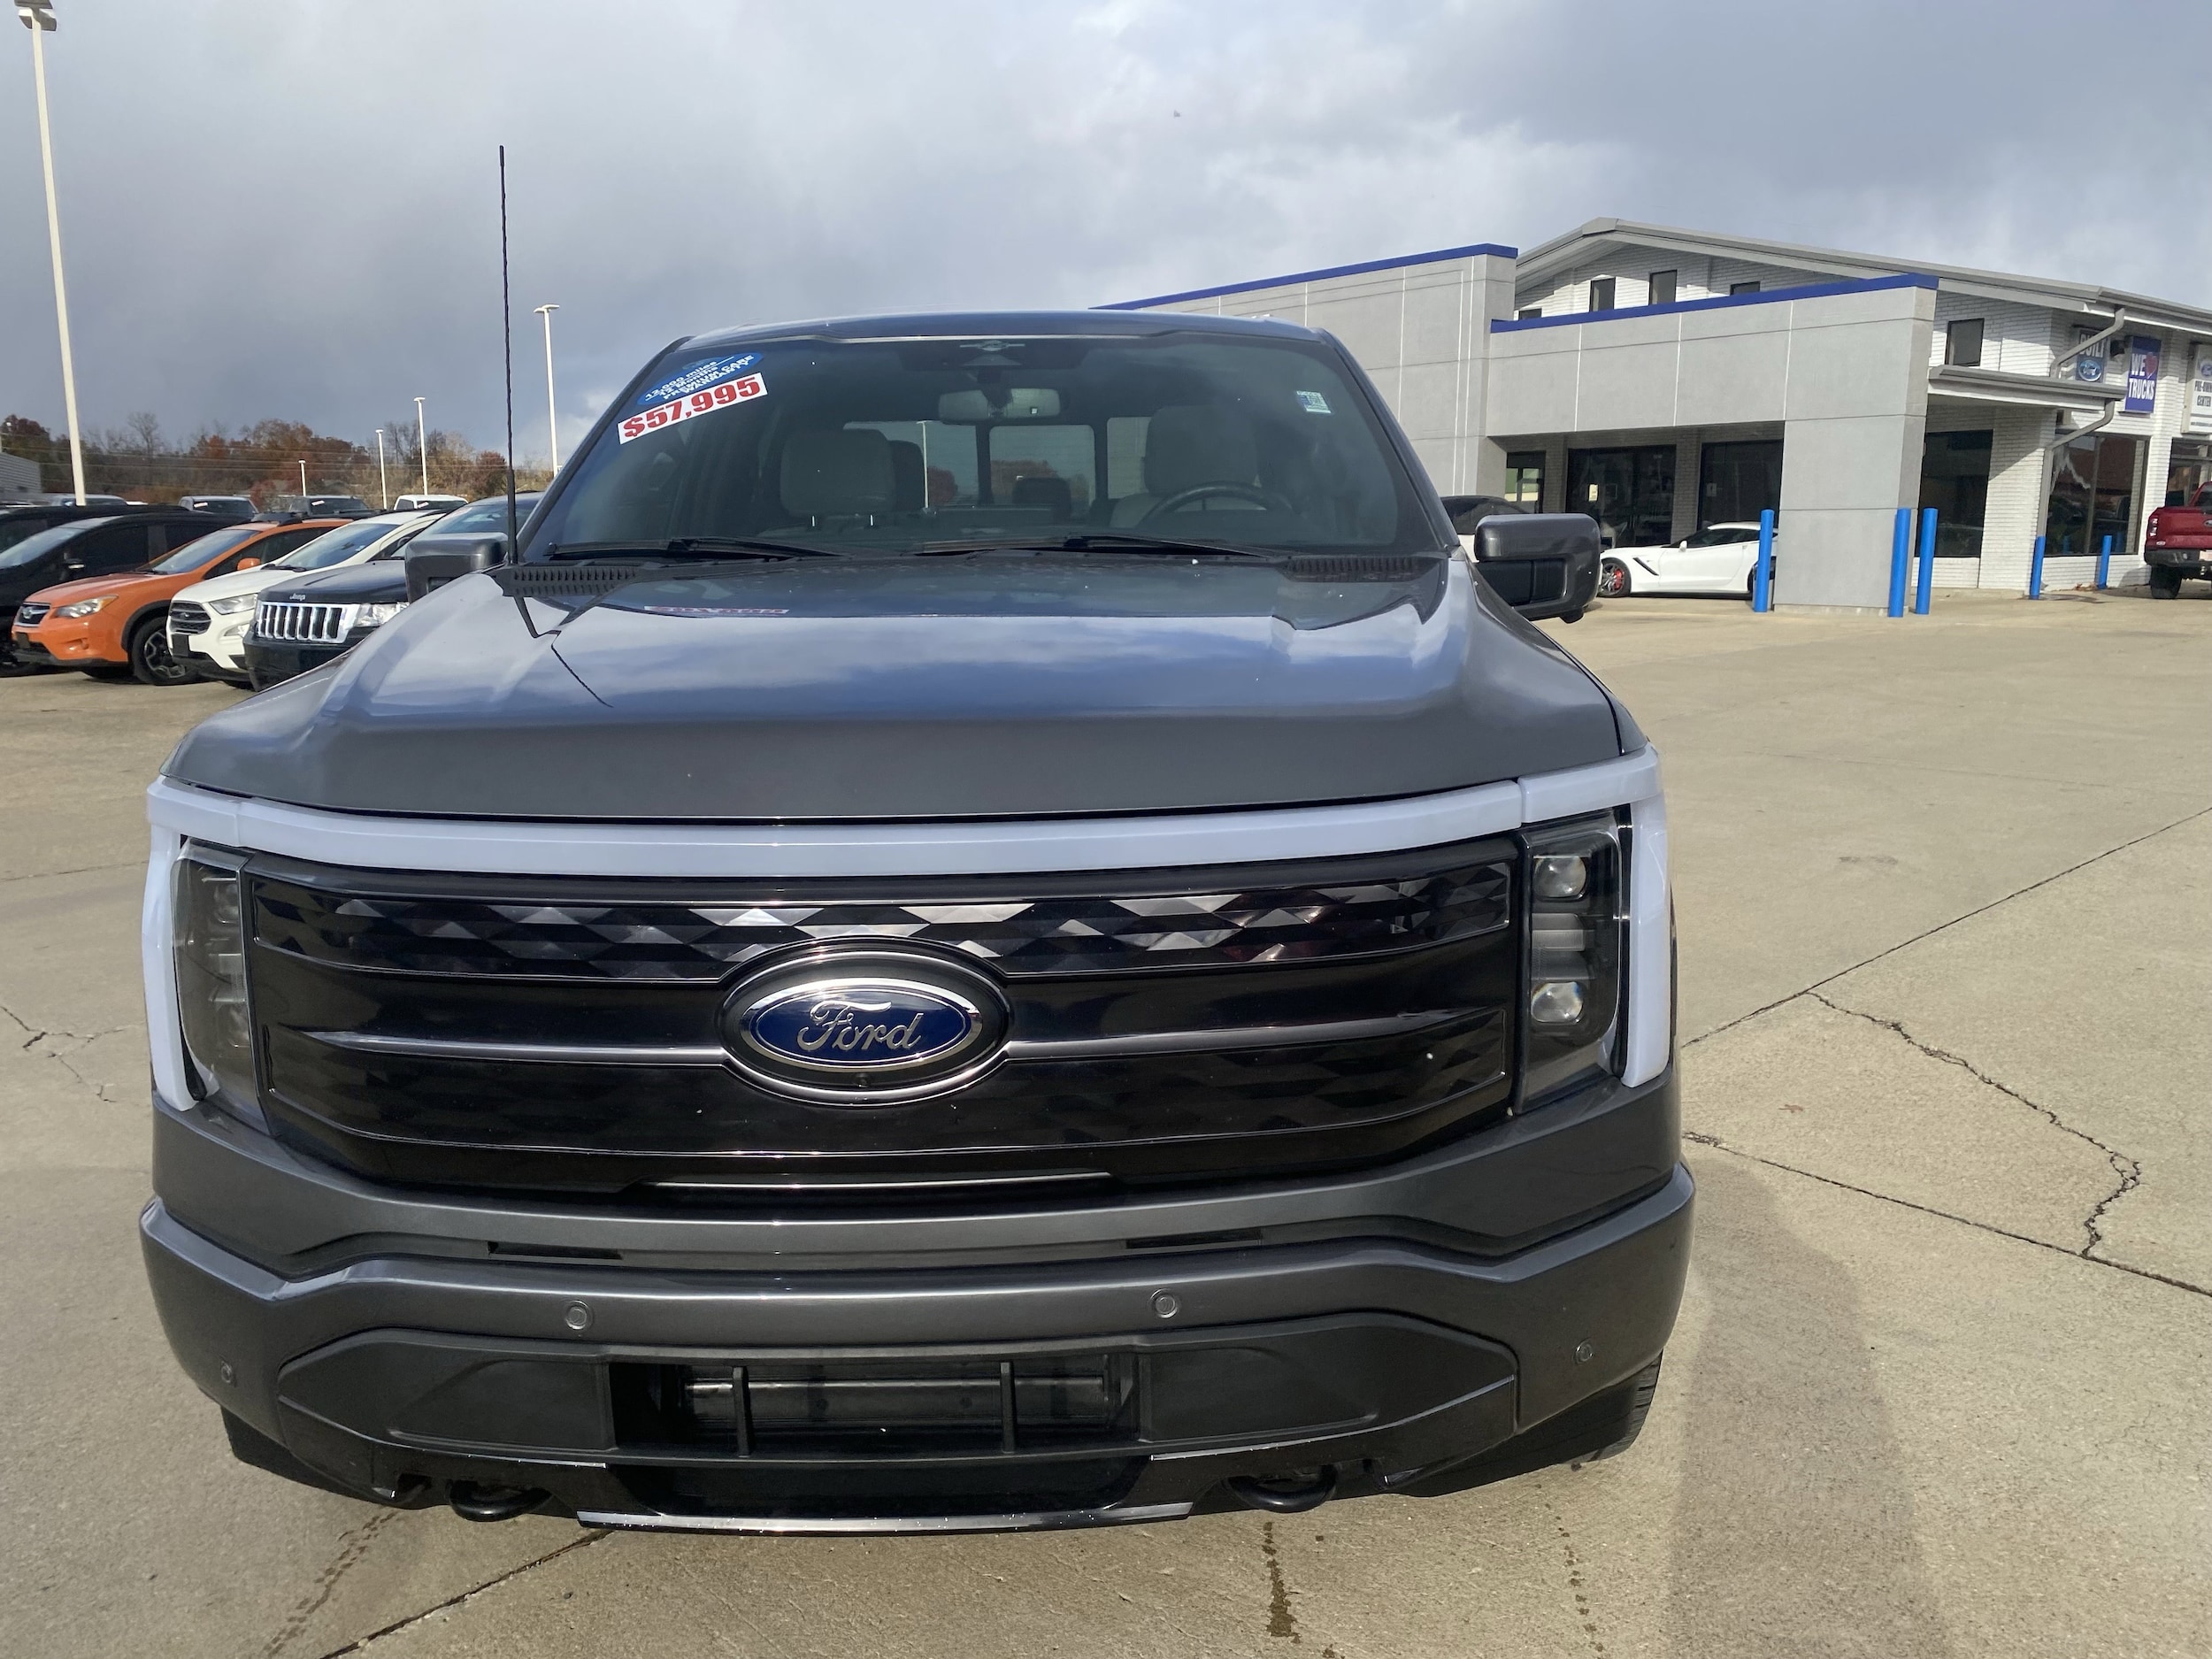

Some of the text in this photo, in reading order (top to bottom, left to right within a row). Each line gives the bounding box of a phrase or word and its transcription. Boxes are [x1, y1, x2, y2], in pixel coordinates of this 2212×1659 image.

[685, 362, 717, 377] miles
[720, 355, 754, 372] CARE
[2131, 353, 2147, 376] WE
[675, 367, 718, 388] Months
[2129, 378, 2154, 400] TRUCKS
[624, 377, 760, 437] $57,995
[797, 1000, 924, 1051] Ford
